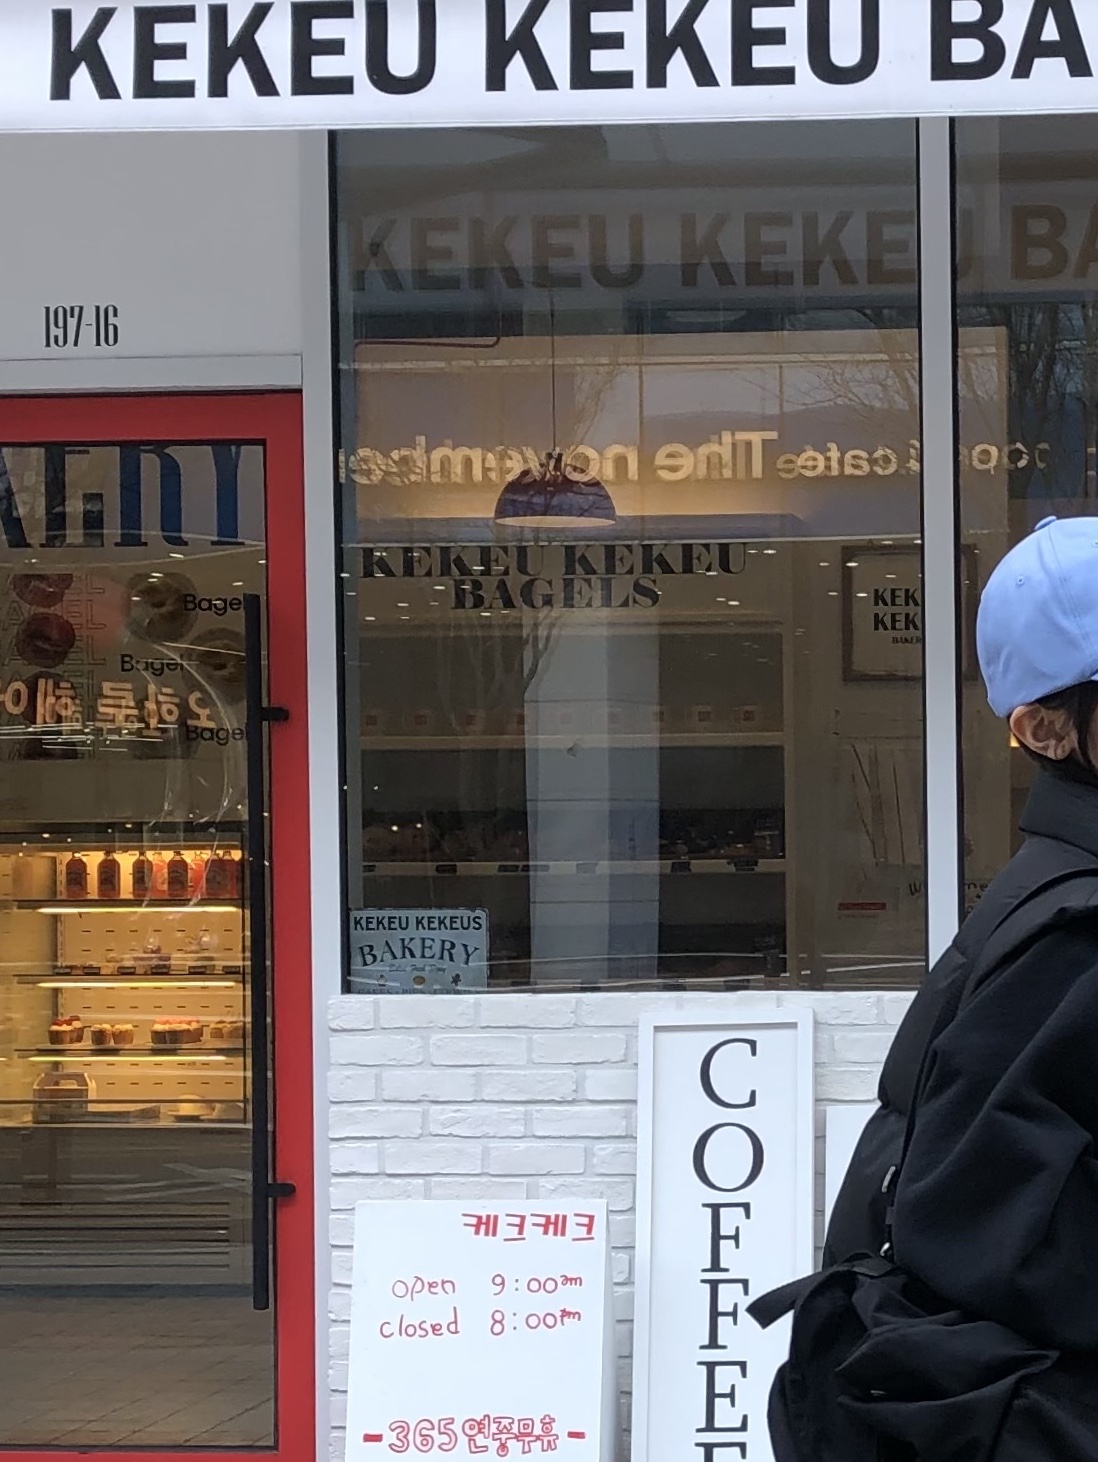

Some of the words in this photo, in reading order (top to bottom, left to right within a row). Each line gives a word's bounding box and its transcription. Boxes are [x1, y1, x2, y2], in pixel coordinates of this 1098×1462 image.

[49, 0, 437, 100] KEKEU
[485, 0, 880, 93] KEKEU
[352, 212, 645, 291] KEKEU
[43, 304, 119, 348] 197-16
[360, 543, 544, 579] KEKEU
[562, 541, 748, 577] KEKEU
[182, 593, 242, 617] Bage
[452, 576, 661, 610] BAGELS
[186, 726, 245, 747] Bage
[354, 915, 410, 931] KEKEU
[416, 915, 483, 931] KEKEUS
[358, 937, 480, 967] BAKERY
[461, 1212, 596, 1242] 케크케크
[391, 1275, 456, 1302] open
[379, 1306, 460, 1338] closed
